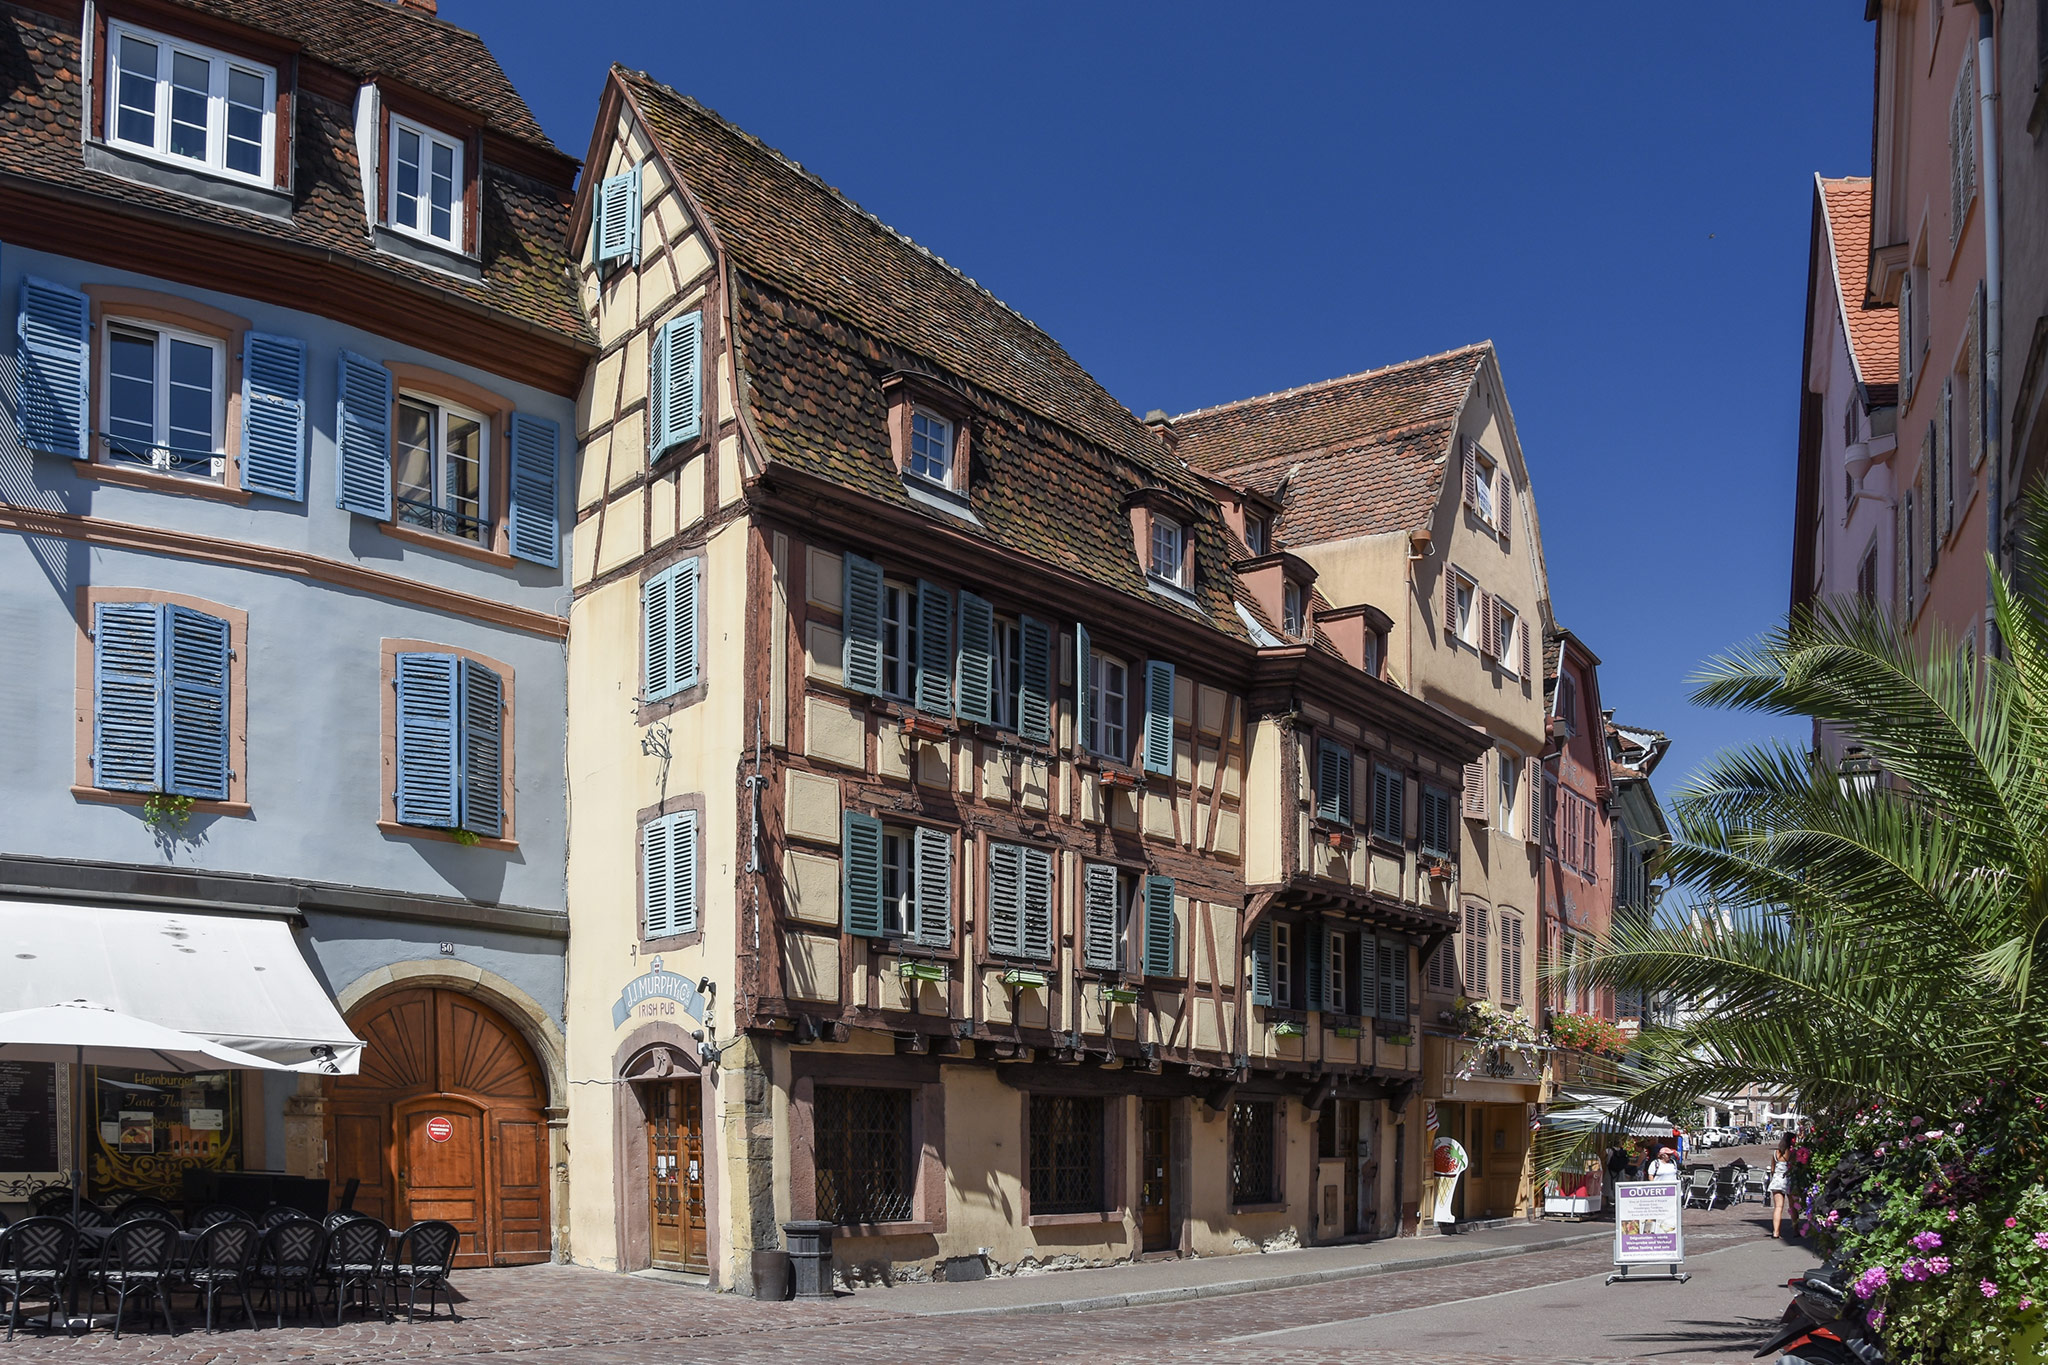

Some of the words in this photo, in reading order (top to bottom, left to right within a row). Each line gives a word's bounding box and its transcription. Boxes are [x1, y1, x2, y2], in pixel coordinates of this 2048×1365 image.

[441, 943, 453, 953] 50
[639, 976, 681, 998] MURPHY
[638, 1003, 658, 1018] IRISH
[660, 1002, 675, 1015] PUB
[124, 1093, 156, 1108] Tarte
[1629, 1188, 1667, 1197] OUVERT
